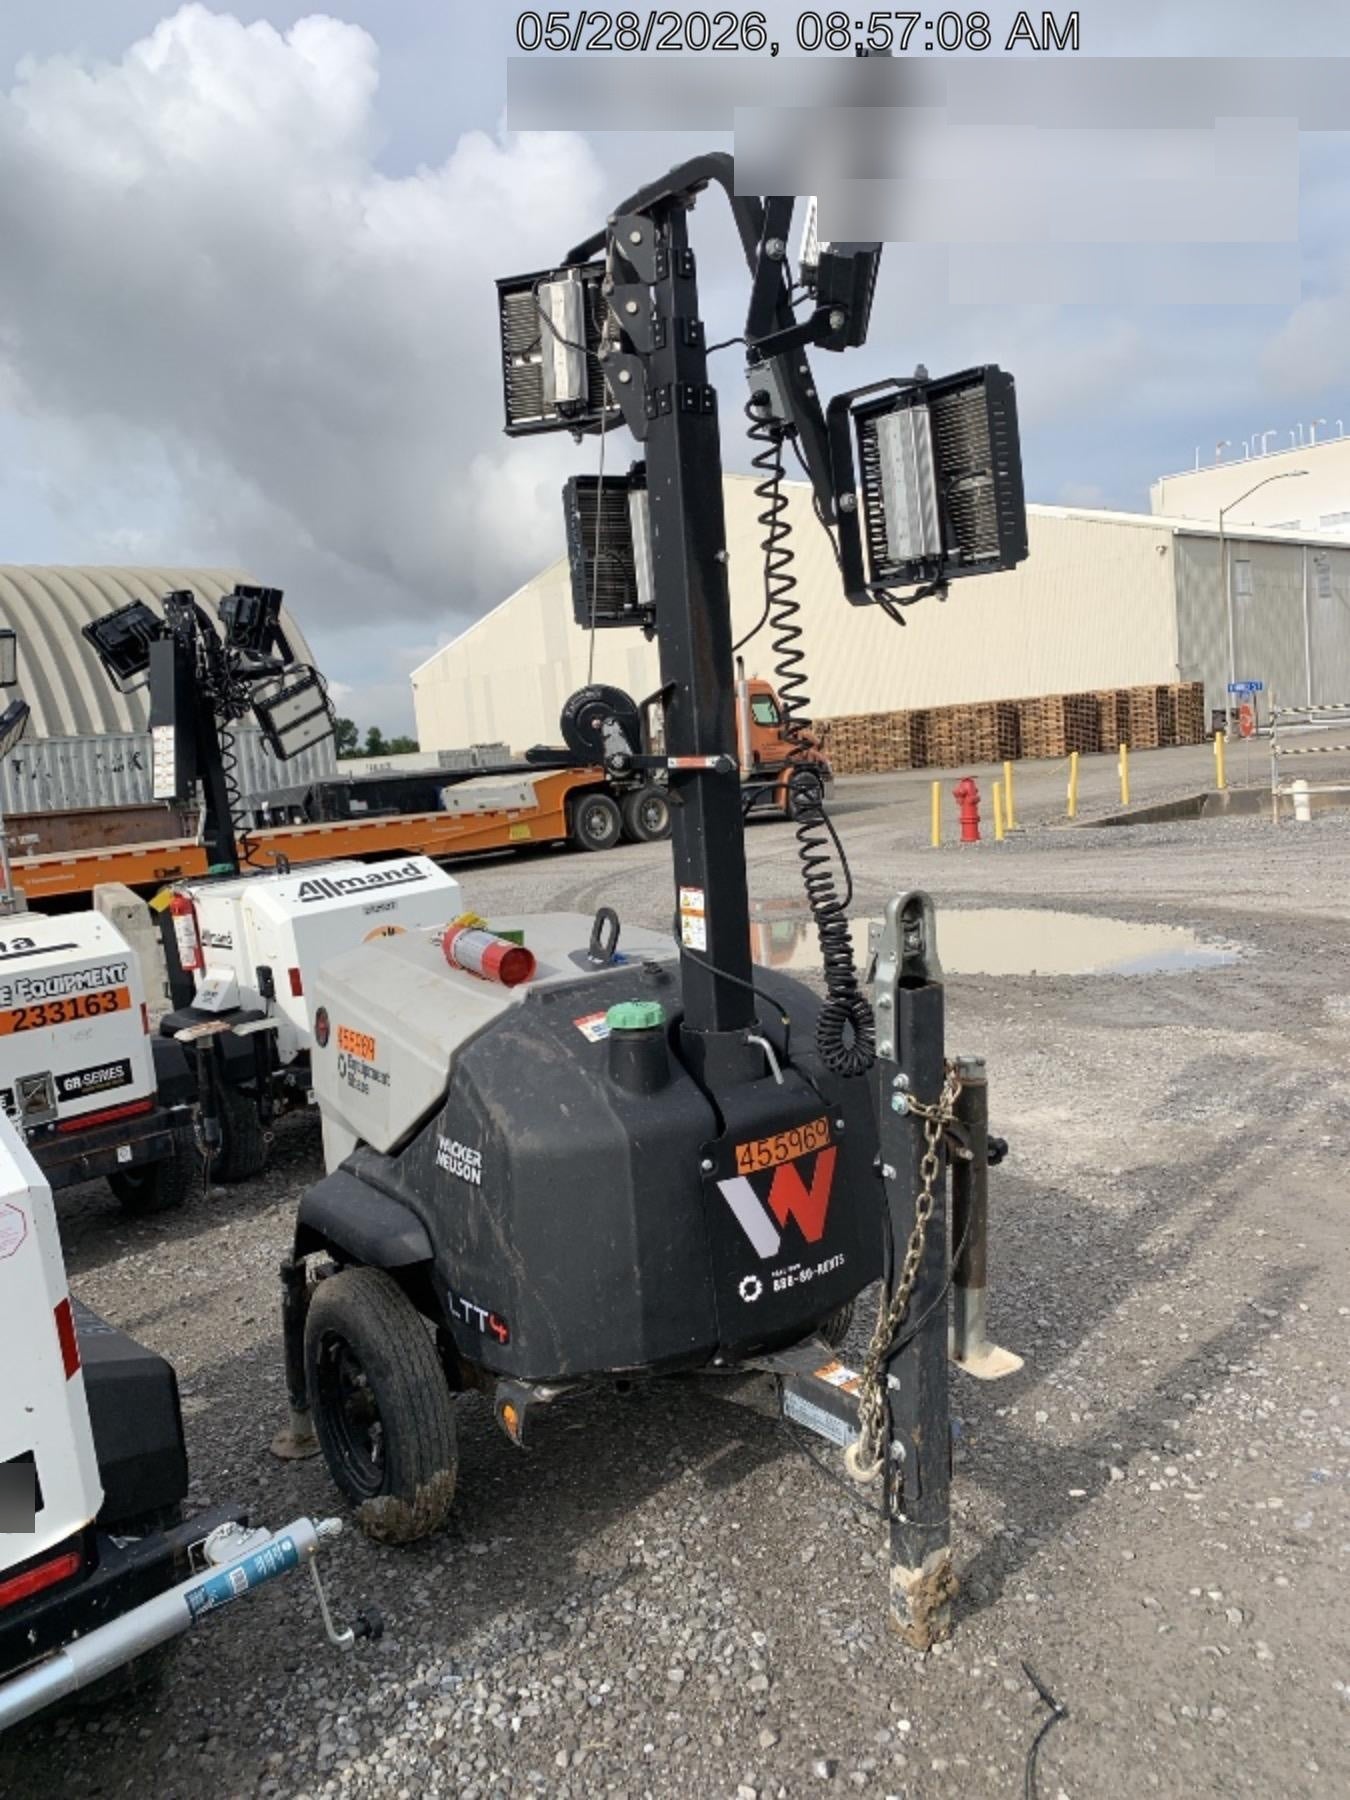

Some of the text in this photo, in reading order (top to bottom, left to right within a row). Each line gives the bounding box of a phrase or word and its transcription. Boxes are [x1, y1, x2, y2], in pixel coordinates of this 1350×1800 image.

[298, 862, 423, 899] Allmand
[14, 962, 129, 1002] EQUIPMENT
[11, 989, 120, 1033] 233163
[437, 1134, 483, 1169] WACKER
[738, 1118, 827, 1170] 455969
[435, 1149, 482, 1185] NEUSON
